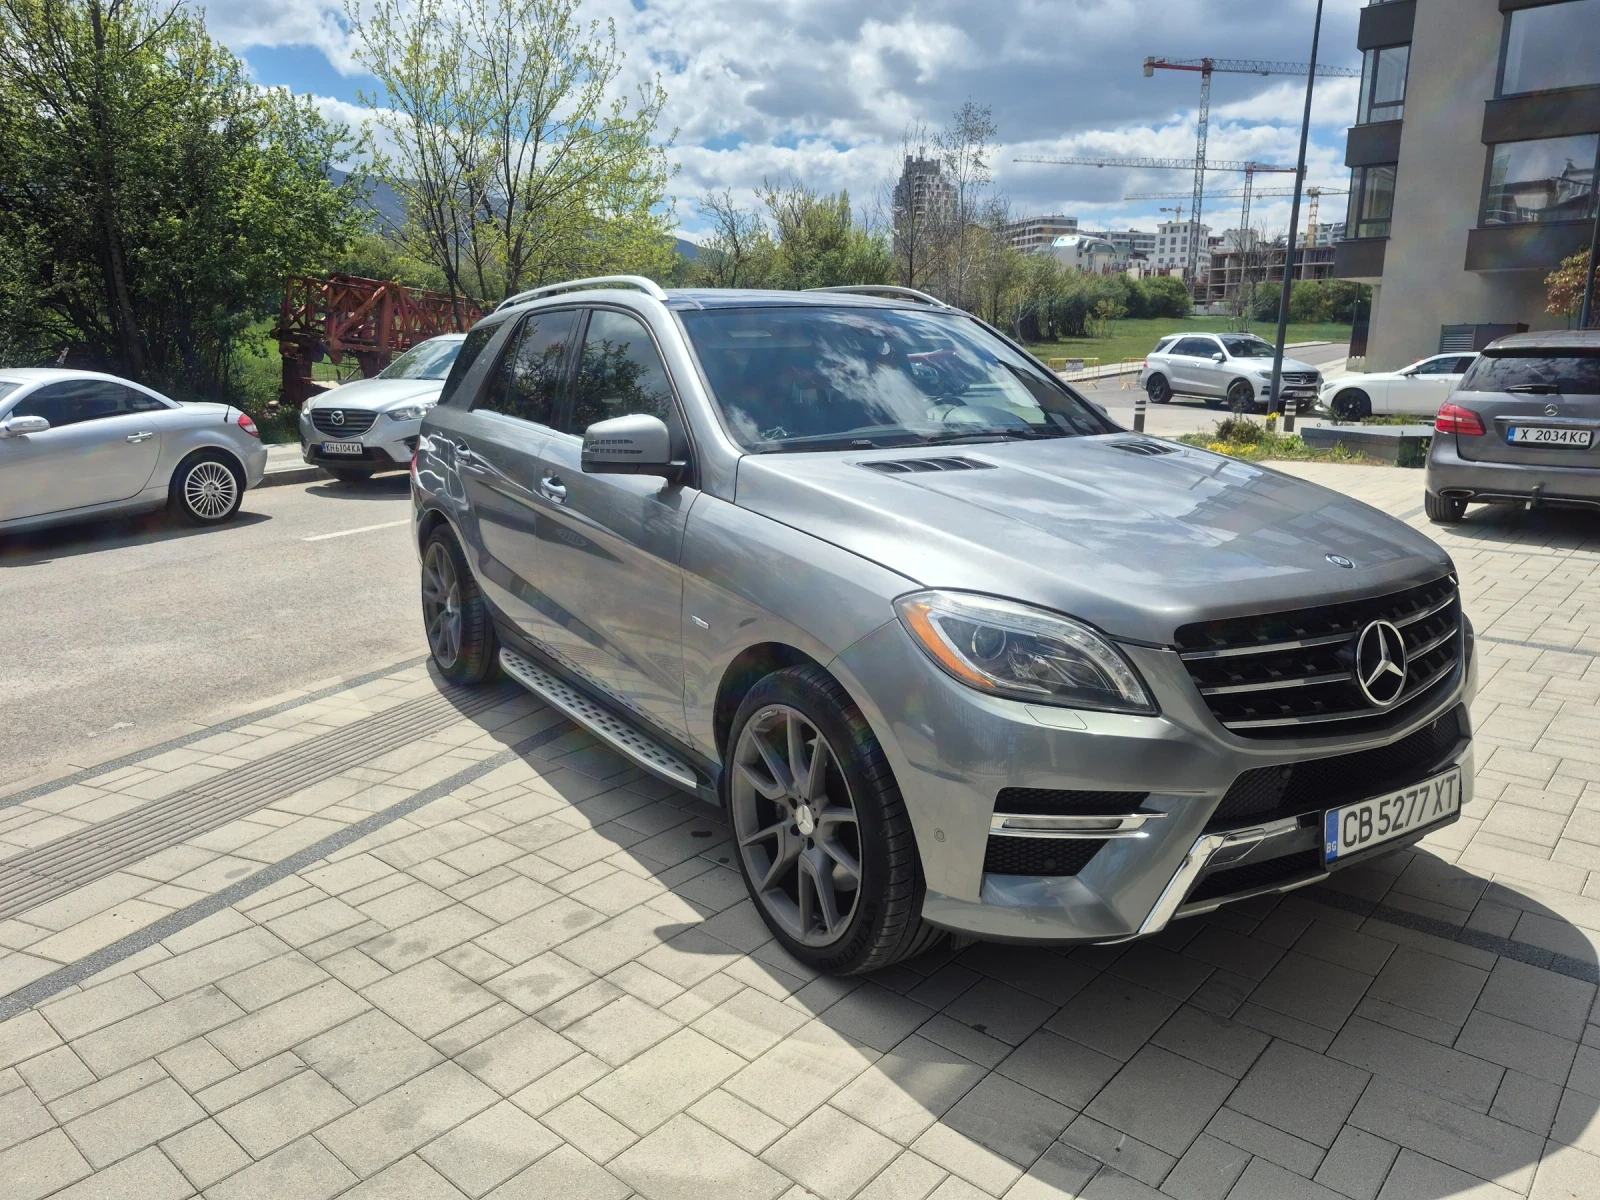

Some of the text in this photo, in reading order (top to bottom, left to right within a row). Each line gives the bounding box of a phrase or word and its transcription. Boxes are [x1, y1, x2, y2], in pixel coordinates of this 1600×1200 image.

[1520, 429, 1530, 441] X
[1535, 429, 1567, 443] 2034
[1343, 774, 1457, 848] CB 5277 XT
[1326, 840, 1337, 854] BG
